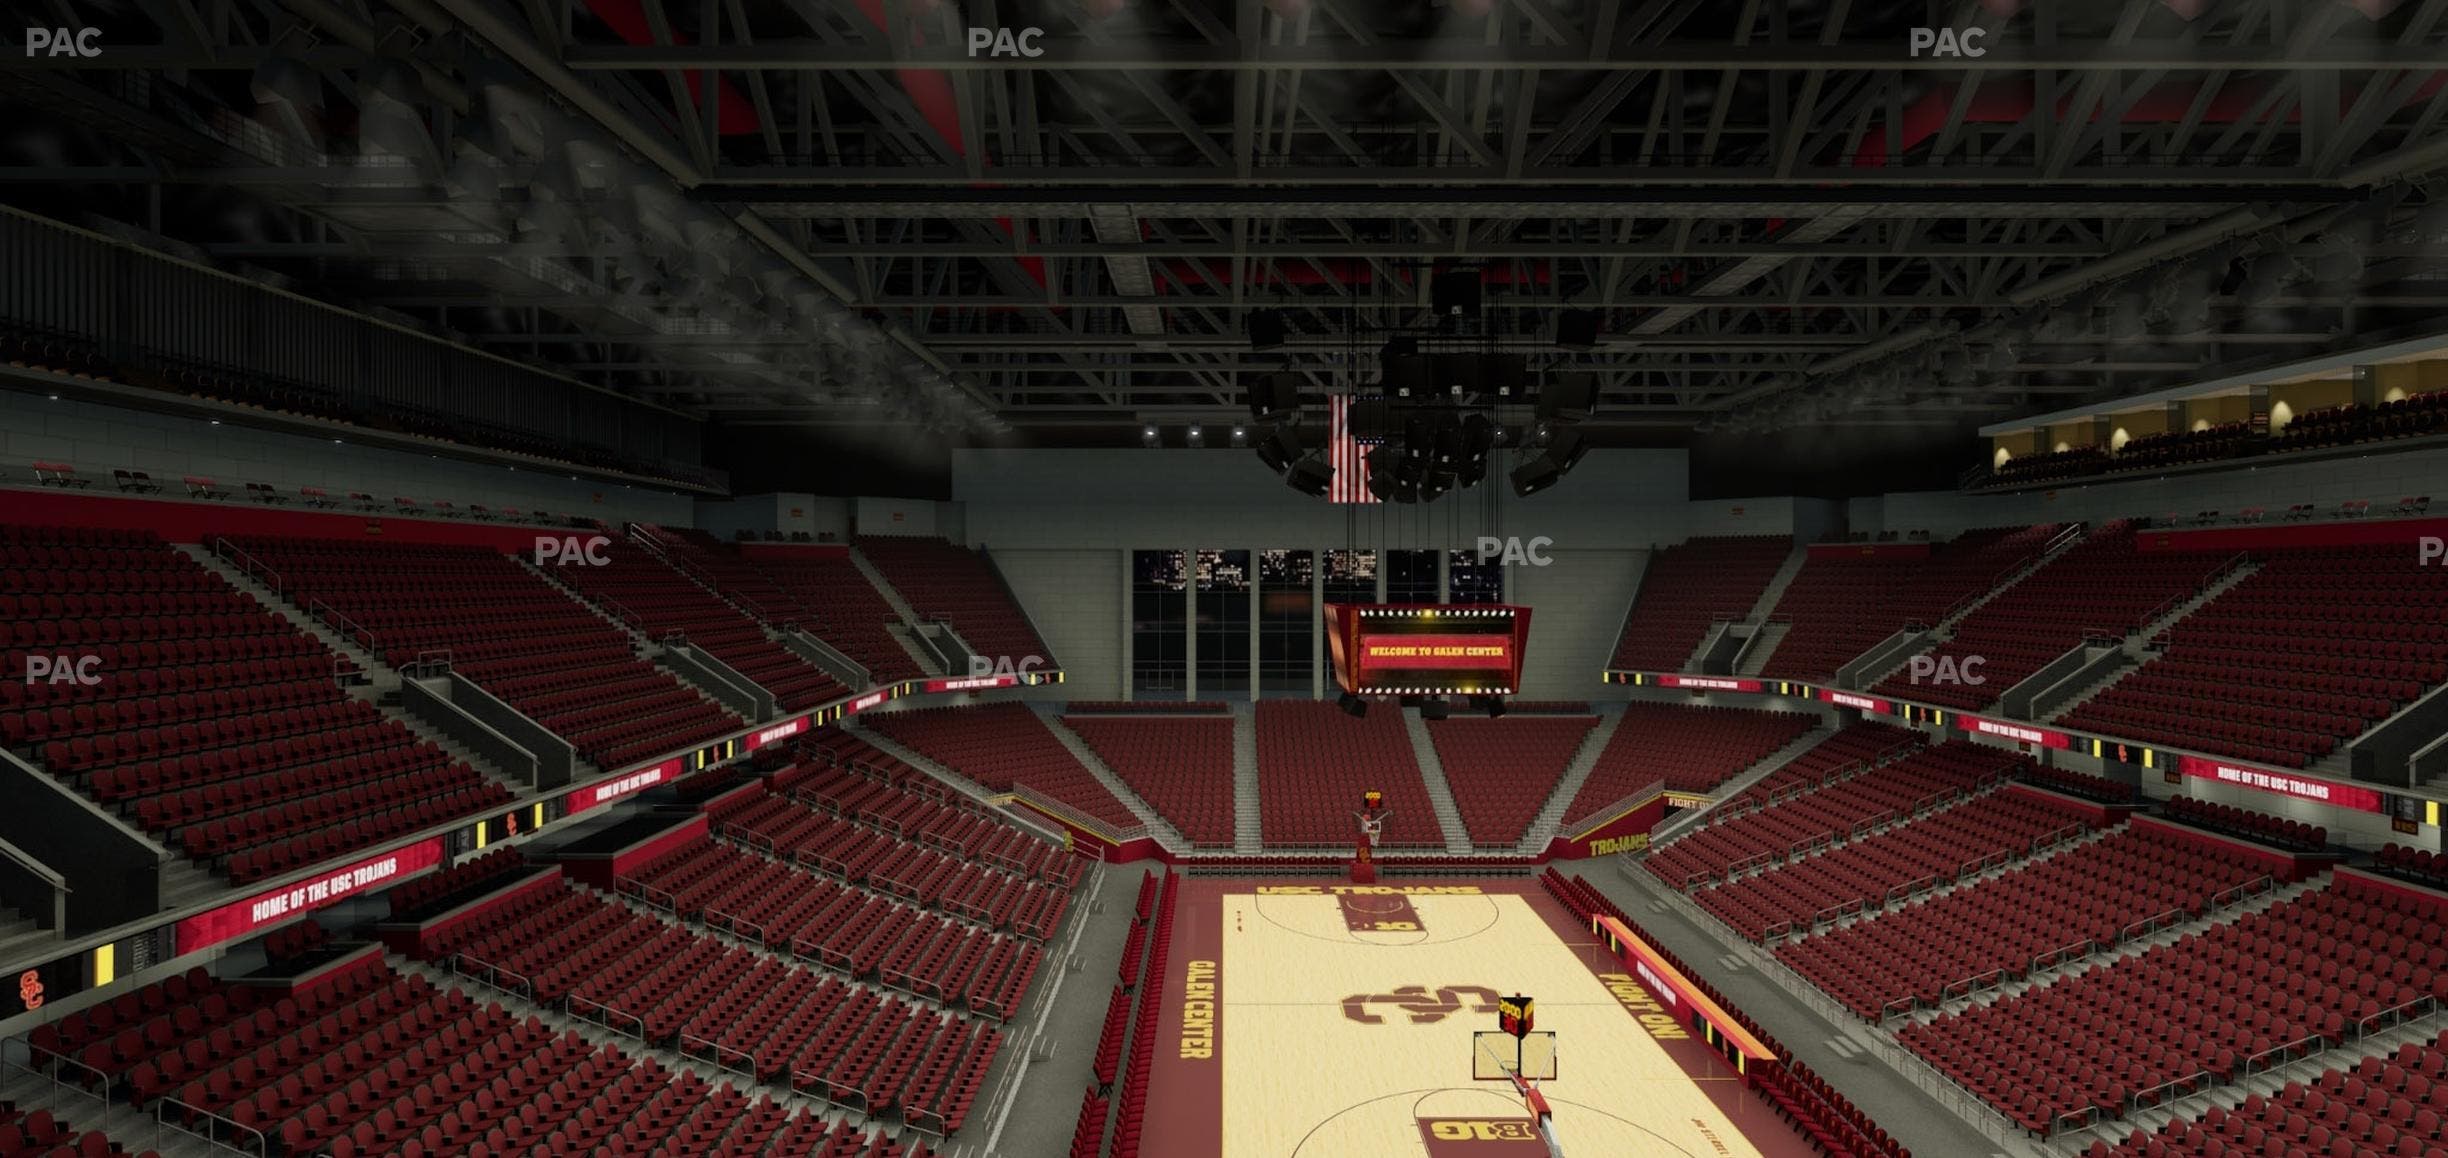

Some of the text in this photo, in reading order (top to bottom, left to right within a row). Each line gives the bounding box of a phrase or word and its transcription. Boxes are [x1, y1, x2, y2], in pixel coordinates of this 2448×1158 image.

[1370, 646, 1504, 656] WELCOME TO GALEN CENTER
[2217, 766, 2329, 800] HOME OF THE USC TROJANS
[1589, 832, 1648, 857] TROJANS
[252, 857, 397, 923] HOME OF THE USC TROJANS
[1179, 960, 1216, 1059] GALEN CENTER
[1598, 974, 1665, 1012] FIGHT
